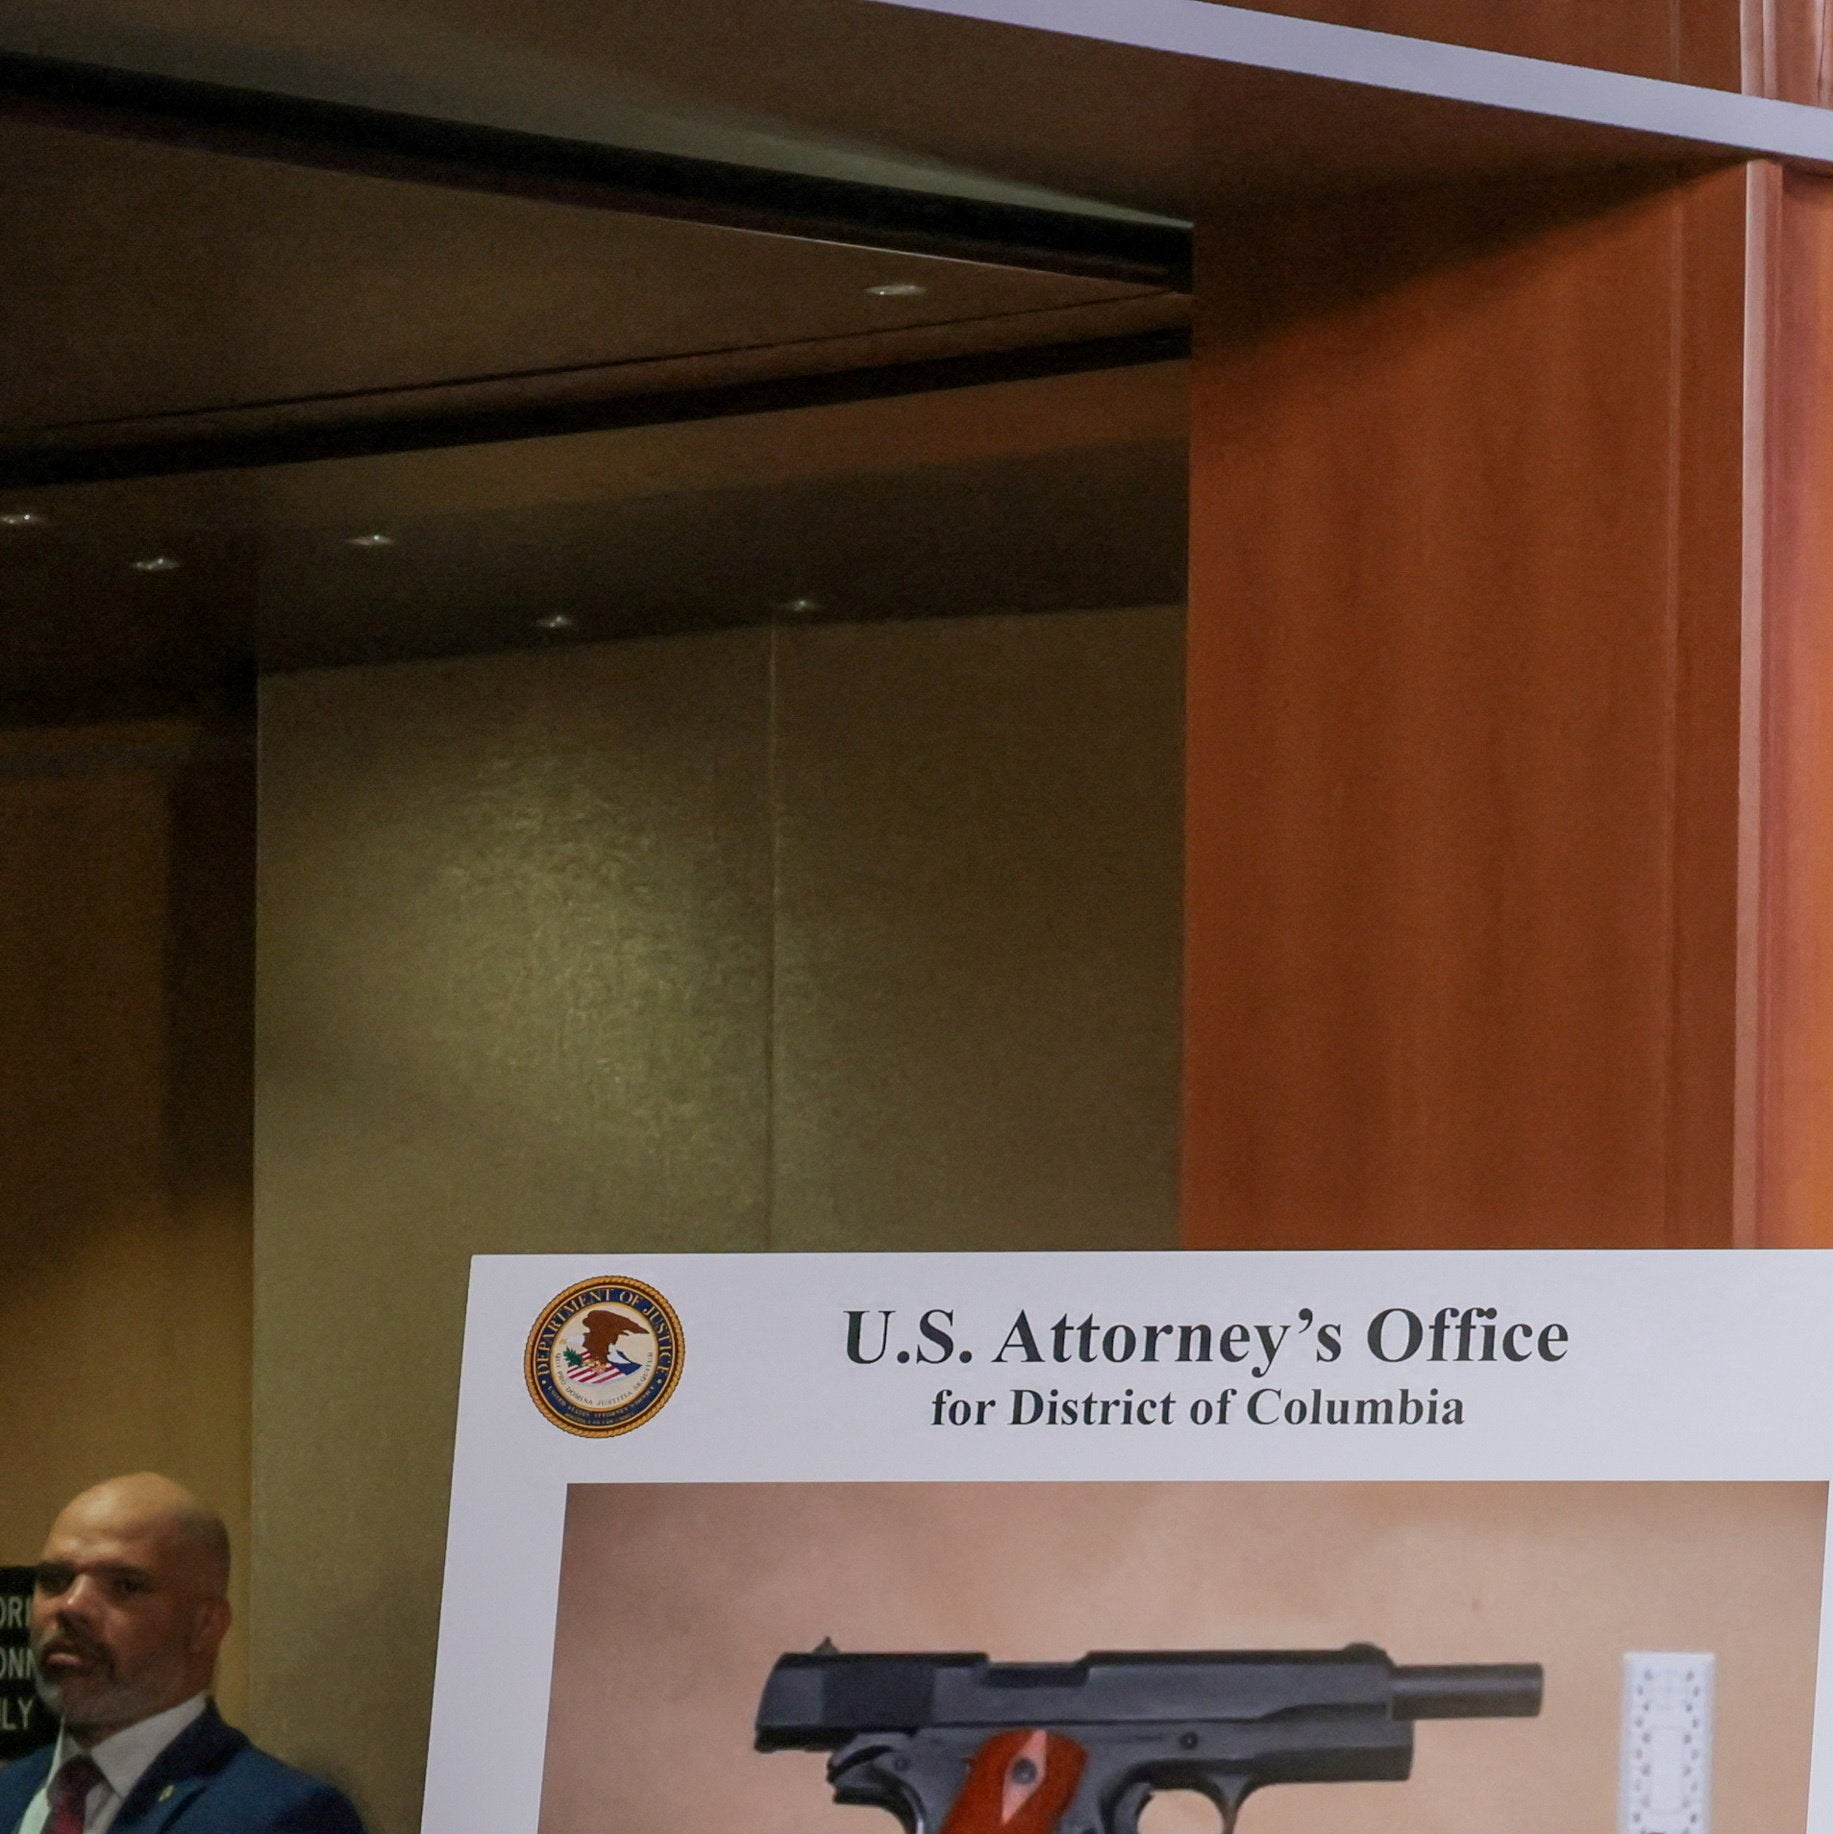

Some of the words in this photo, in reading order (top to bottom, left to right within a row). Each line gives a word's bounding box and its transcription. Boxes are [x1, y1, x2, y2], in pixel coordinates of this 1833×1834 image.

[538, 1288, 614, 1376] DEPARTMENT
[619, 1291, 641, 1306] OF
[643, 1306, 672, 1375] JUSTICE
[843, 1308, 973, 1365] U.S.
[992, 1308, 1342, 1377] Attorney's
[1367, 1307, 1569, 1364] Office
[931, 1389, 996, 1427] for
[1008, 1389, 1176, 1427] District
[1190, 1388, 1238, 1427] of
[1247, 1388, 1465, 1427] Columbia
